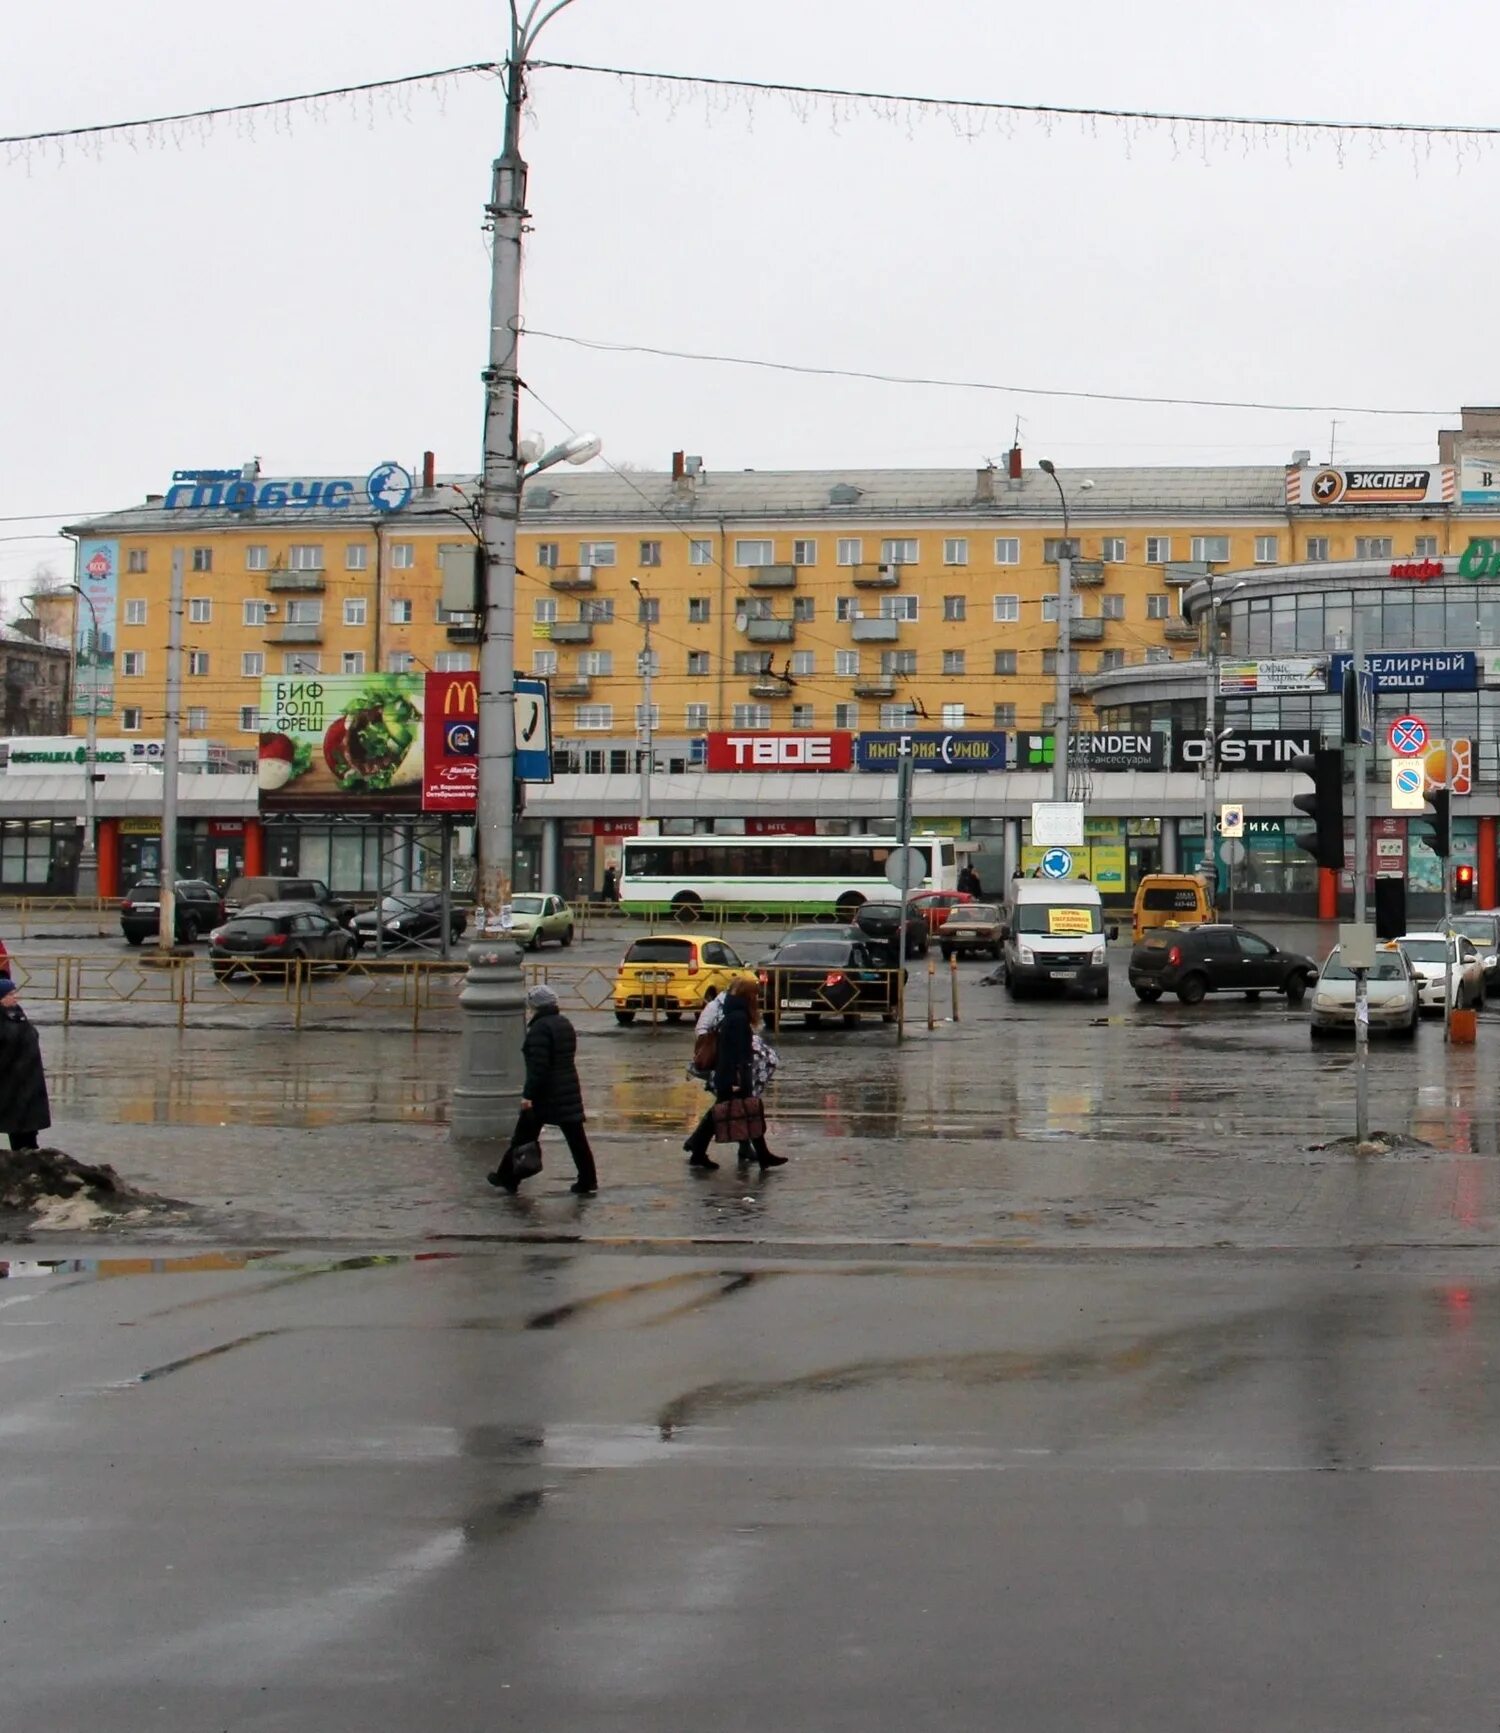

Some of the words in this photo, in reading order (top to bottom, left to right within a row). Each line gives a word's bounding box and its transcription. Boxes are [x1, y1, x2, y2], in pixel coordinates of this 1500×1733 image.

[1351, 473, 1425, 488] ЭКСПЕРТ
[164, 481, 354, 511] ГЛОБУС
[1378, 676, 1424, 686] ZOLLO
[276, 682, 323, 701] БИФ
[276, 701, 323, 716] РОЛЛ
[276, 717, 323, 733] ФРЕШ
[727, 737, 831, 764] ТВОЕ
[1182, 739, 1310, 762] OSTIN
[1095, 756, 1152, 765] аксессуары
